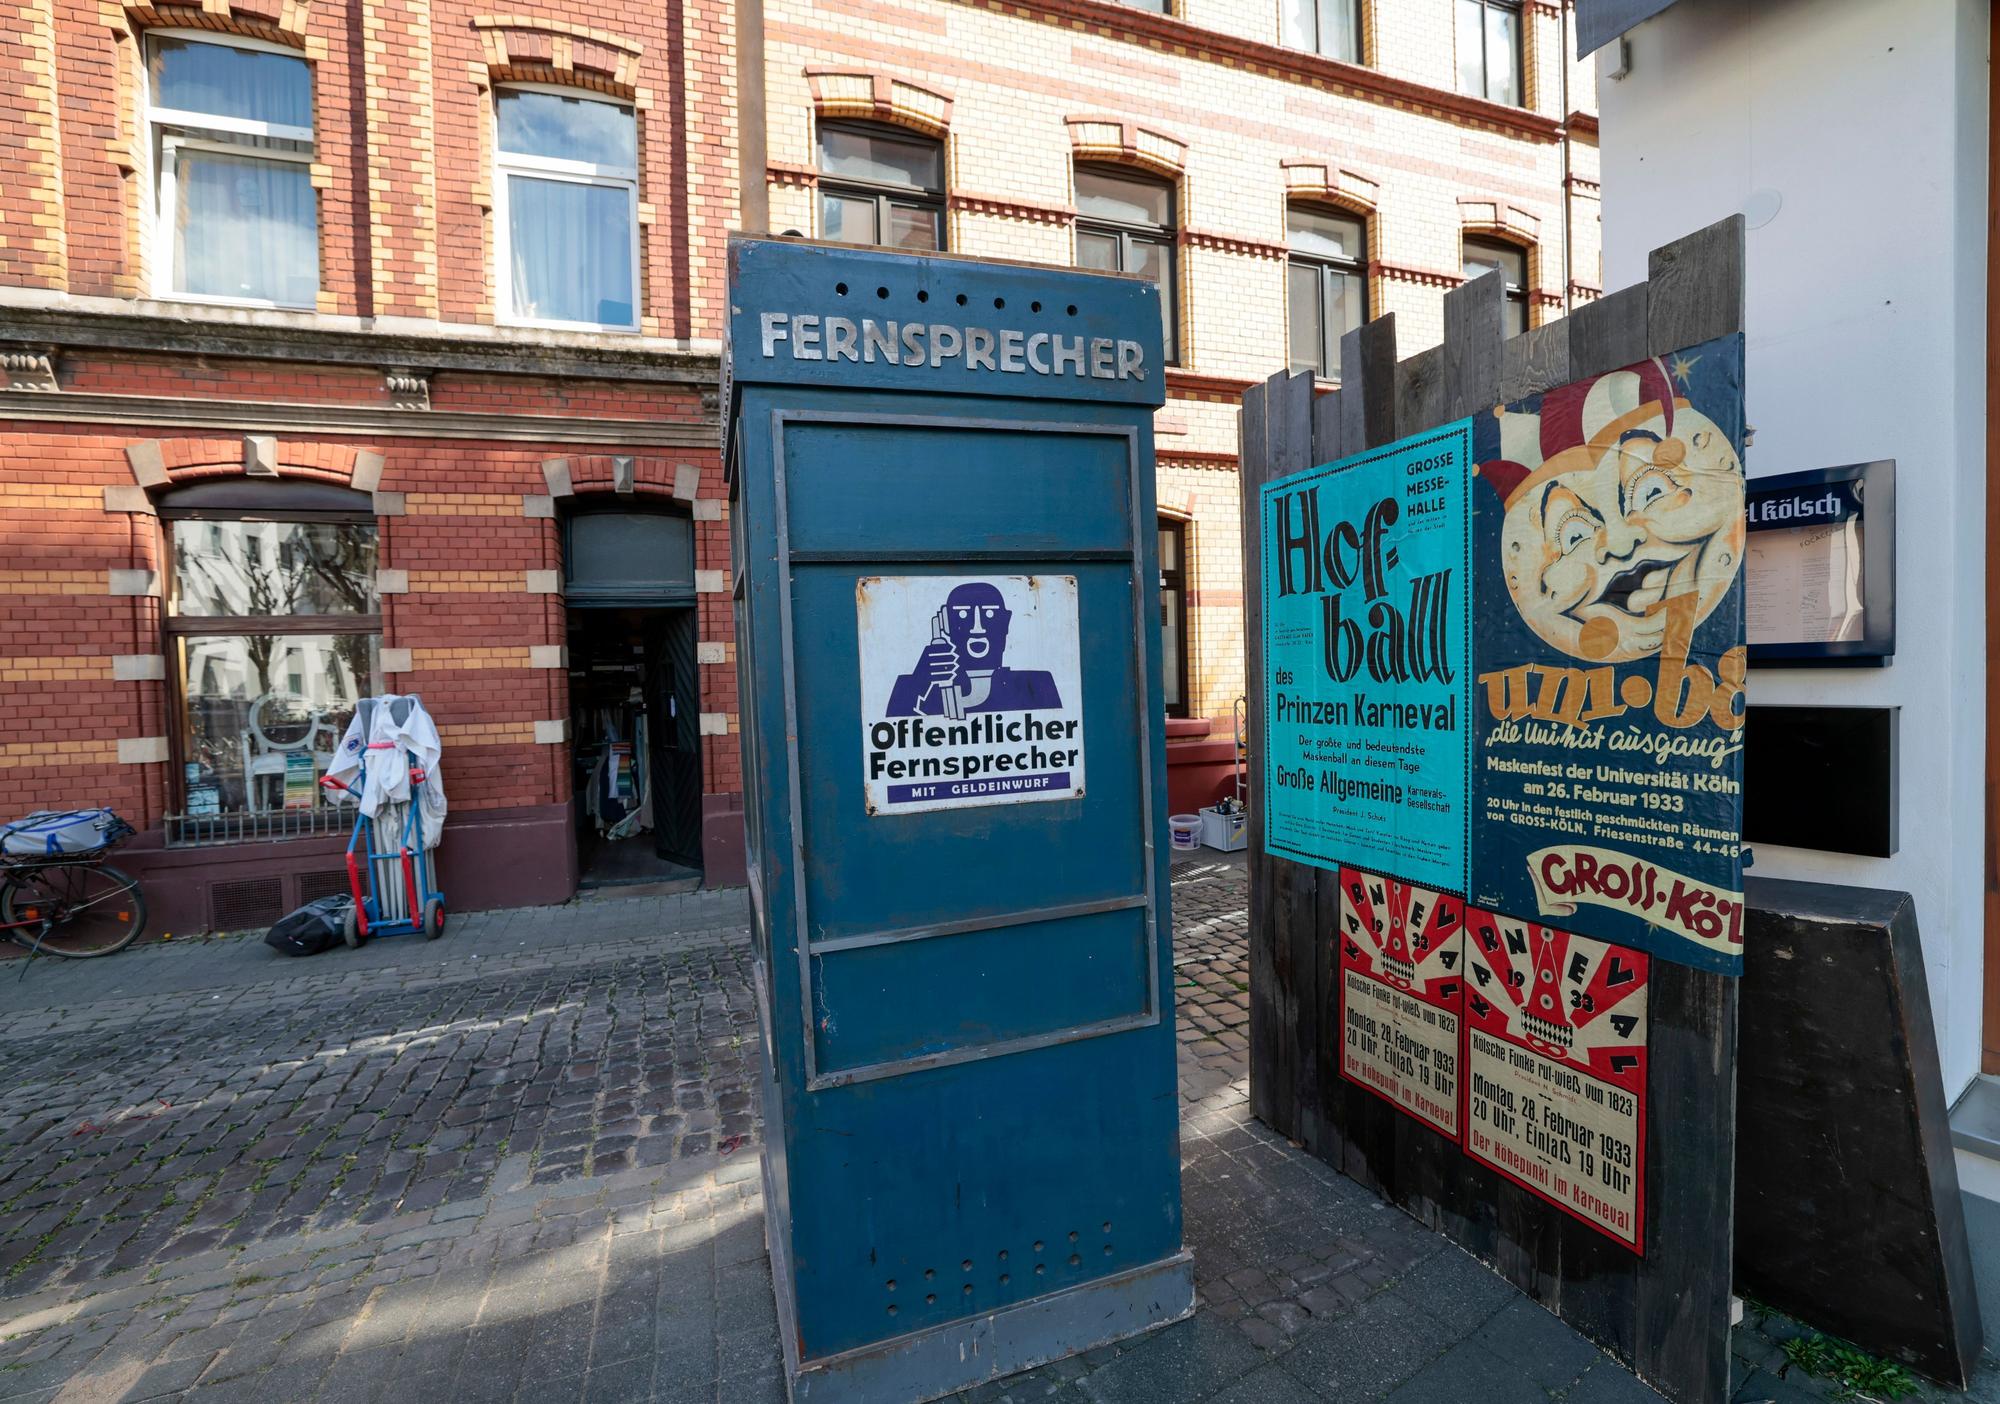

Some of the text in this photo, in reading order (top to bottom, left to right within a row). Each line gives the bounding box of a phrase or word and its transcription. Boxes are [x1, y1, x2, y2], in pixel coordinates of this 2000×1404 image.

[760, 312, 1145, 381] FERNSPRECHER
[1406, 452, 1454, 476] GROSSE
[1406, 476, 1450, 497] MESSE-
[1407, 497, 1446, 517] HALLE
[1761, 492, 1841, 521] Kölsch
[1320, 569, 1456, 685] ball
[1276, 666, 1293, 685] des
[1277, 693, 1455, 731] Prinzen Karneval
[869, 713, 1078, 750] Öffentlicher
[1299, 734, 1313, 746] Der
[1346, 738, 1362, 750] und
[1365, 738, 1425, 756] bedeutendste
[1557, 724, 1605, 749] hat
[870, 745, 1078, 780] Fernsprecher
[1303, 751, 1348, 764] Maskenball
[1364, 755, 1396, 769] diesem
[1398, 758, 1420, 775] Tage
[1487, 756, 1740, 795] Maskenfest der Universität Köln
[911, 777, 1049, 798] MIT GELDEINWURF
[1277, 765, 1403, 804] Große Allgemeine
[1407, 785, 1447, 799] Karnevals-
[1523, 782, 1684, 813] am 26. Februar 1933
[1407, 798, 1450, 813] Gesellschaft
[1487, 797, 1739, 842] 20 Uhr in den festlich geschmückten Räumen
[1487, 811, 1505, 821] von
[1593, 826, 1684, 850] Friesenstraße
[1693, 840, 1739, 858] 44-46
[1371, 917, 1429, 951] 19 33
[1347, 973, 1371, 996] Kölsche
[1372, 984, 1391, 1004] Funke
[1422, 1008, 1436, 1025] vun
[1438, 1013, 1455, 1034] 1823
[1507, 968, 1595, 1013] 19 33
[1347, 1006, 1378, 1038] Montag,
[1381, 1023, 1394, 1044] 28.
[1395, 1030, 1430, 1063] Februar
[1433, 1048, 1454, 1076] 1933
[1347, 1027, 1357, 1046] 20
[1384, 1044, 1414, 1077] Einlaß
[1419, 1064, 1430, 1085] 19
[1434, 1071, 1454, 1097] Uhr
[1473, 1033, 1506, 1064] Kölsche
[1509, 1048, 1535, 1074] Funke
[1585, 1082, 1604, 1105] vun
[1607, 1090, 1633, 1117] 1823
[1347, 1054, 1453, 1127] Der Höhepunkt im Karneval
[1473, 1072, 1631, 1169] Montag, 28. Februar 1933
[1473, 1097, 1487, 1121] 20
[1526, 1122, 1571, 1165] Einlaß
[1579, 1150, 1594, 1177] 19
[1602, 1160, 1631, 1194] Uhr
[1473, 1129, 1630, 1232] Der Höhepunkt im Karneval
